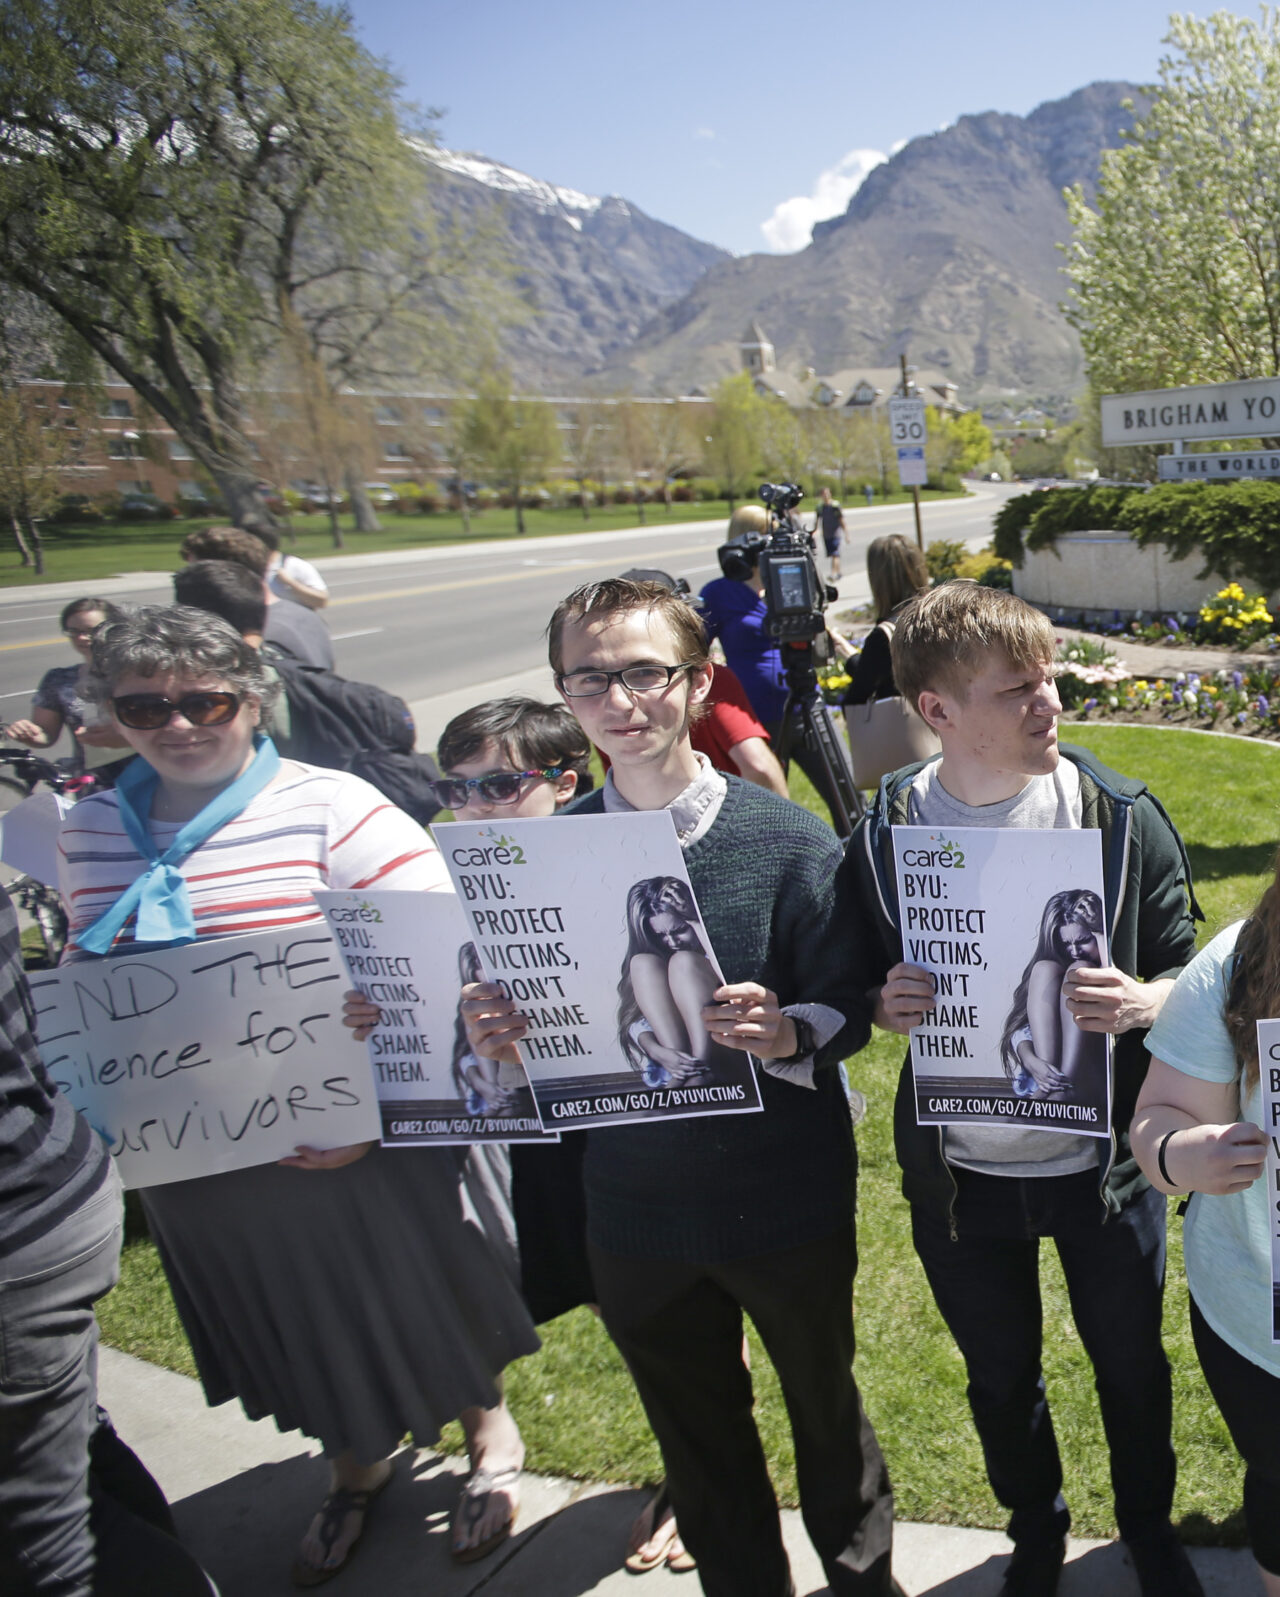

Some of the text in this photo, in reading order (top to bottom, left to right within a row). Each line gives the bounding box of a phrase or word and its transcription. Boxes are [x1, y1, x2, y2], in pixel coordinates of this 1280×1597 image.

[1123, 400, 1229, 430] BRIGHAM
[895, 422, 922, 439] 30
[1176, 459, 1207, 473] THE
[1218, 457, 1280, 471] WORLD
[459, 873, 516, 901] BYU:
[904, 873, 948, 900] BYU:
[471, 907, 566, 936] PROTECT
[906, 906, 986, 934] PROTECT
[336, 927, 377, 949] BYU:
[346, 954, 414, 977] PROTECT
[482, 942, 579, 971] VICTIMS,
[908, 938, 988, 971] VICTIMS,
[192, 938, 341, 998] THE
[929, 972, 969, 997] ON'T
[512, 1004, 589, 1030] HAME
[237, 1011, 331, 1057] for
[371, 1034, 432, 1055] SHAME
[520, 1033, 592, 1060] THEM.
[915, 1034, 974, 1058] THEM.
[375, 1062, 430, 1083] THEM.
[551, 1085, 746, 1119] CARE2.COM/GO/Z/BYUVICTIMS
[928, 1098, 1098, 1122] CARE2.COM/GO/Z/BYUVICTIMS
[390, 1117, 543, 1135] CARE2.COM/GO/Z/BYUVICTIM
